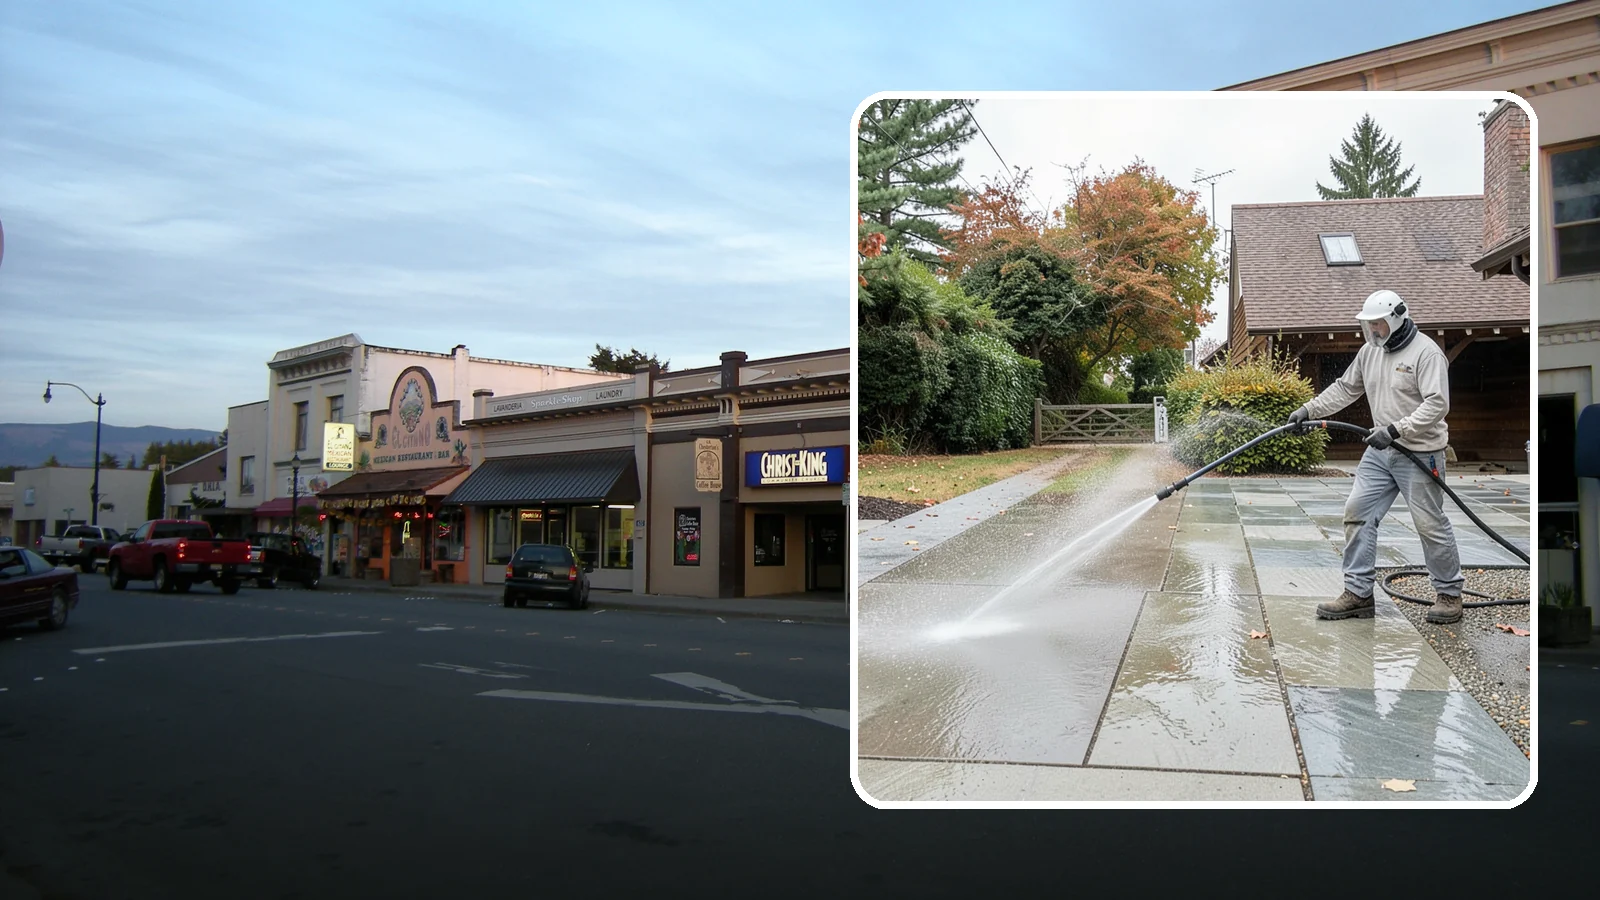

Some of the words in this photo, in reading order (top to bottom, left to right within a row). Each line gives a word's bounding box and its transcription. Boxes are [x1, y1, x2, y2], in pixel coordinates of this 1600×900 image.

[493, 402, 523, 412] LAVANDERIA
[530, 398, 562, 409] Sparkle
[562, 395, 582, 405] Shop
[595, 389, 623, 400] LAUNDRY
[373, 454, 396, 464] MEXICAN
[397, 452, 434, 462] RESTAURANT
[438, 450, 451, 459] BAR
[799, 450, 828, 476] KING
